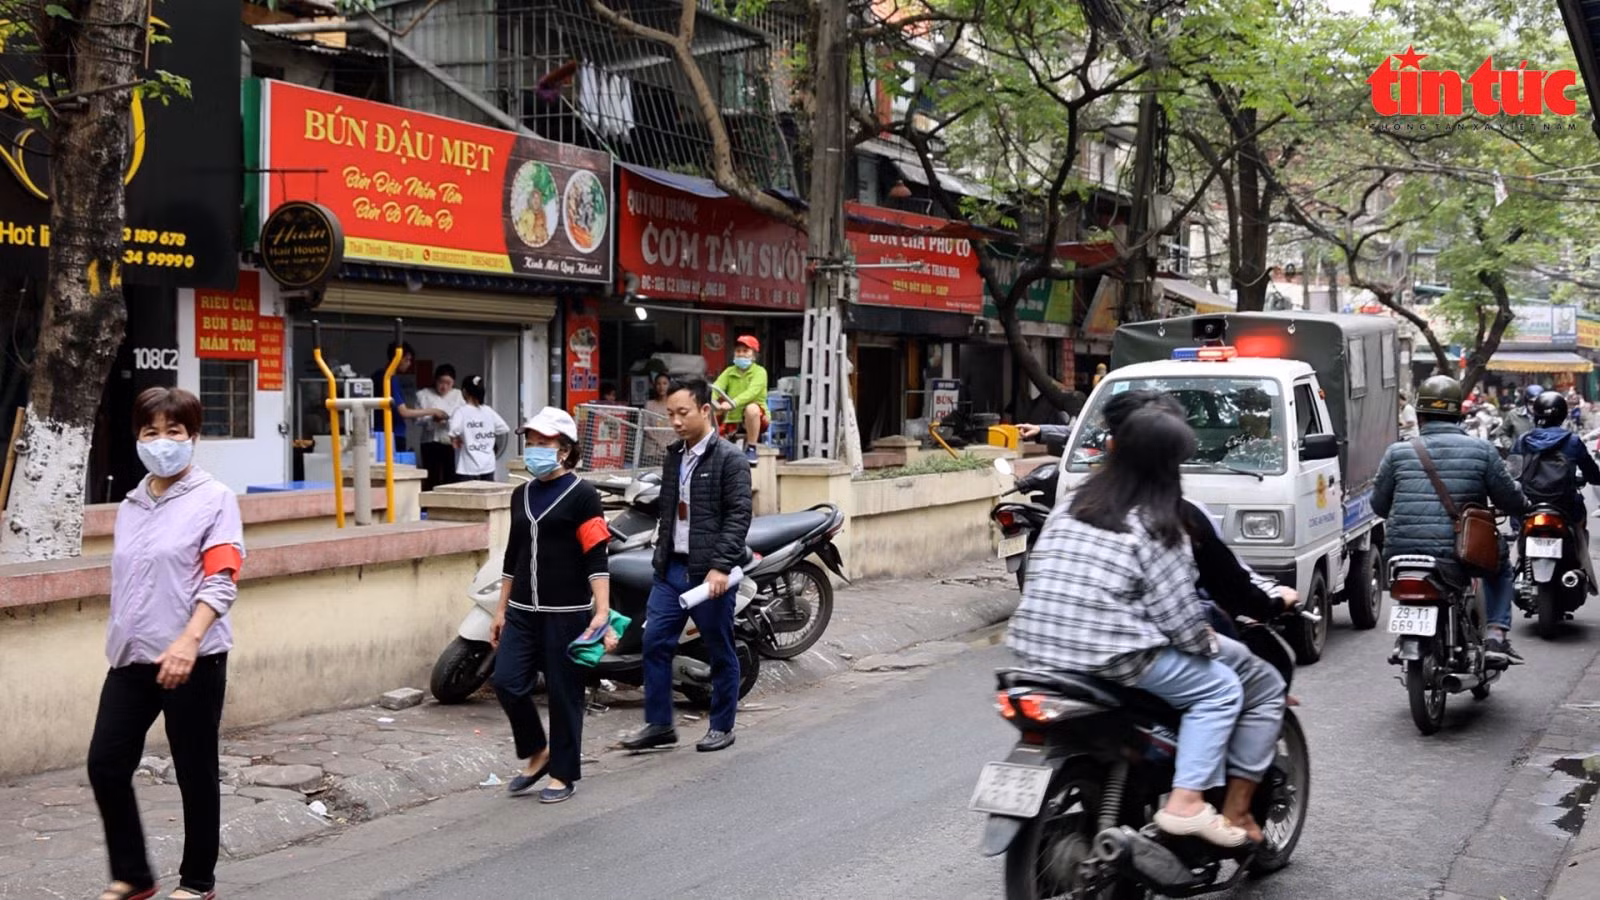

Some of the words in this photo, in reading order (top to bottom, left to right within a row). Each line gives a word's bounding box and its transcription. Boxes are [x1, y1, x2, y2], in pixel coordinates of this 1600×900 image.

[304, 105, 368, 149] BÚN
[375, 119, 434, 164] ĐẬU
[440, 136, 495, 176] MẸT
[0, 221, 35, 246] Hot
[159, 231, 186, 247] 678
[641, 225, 699, 271] CƠM
[705, 221, 753, 276] TẤM
[133, 347, 179, 370] 108C2
